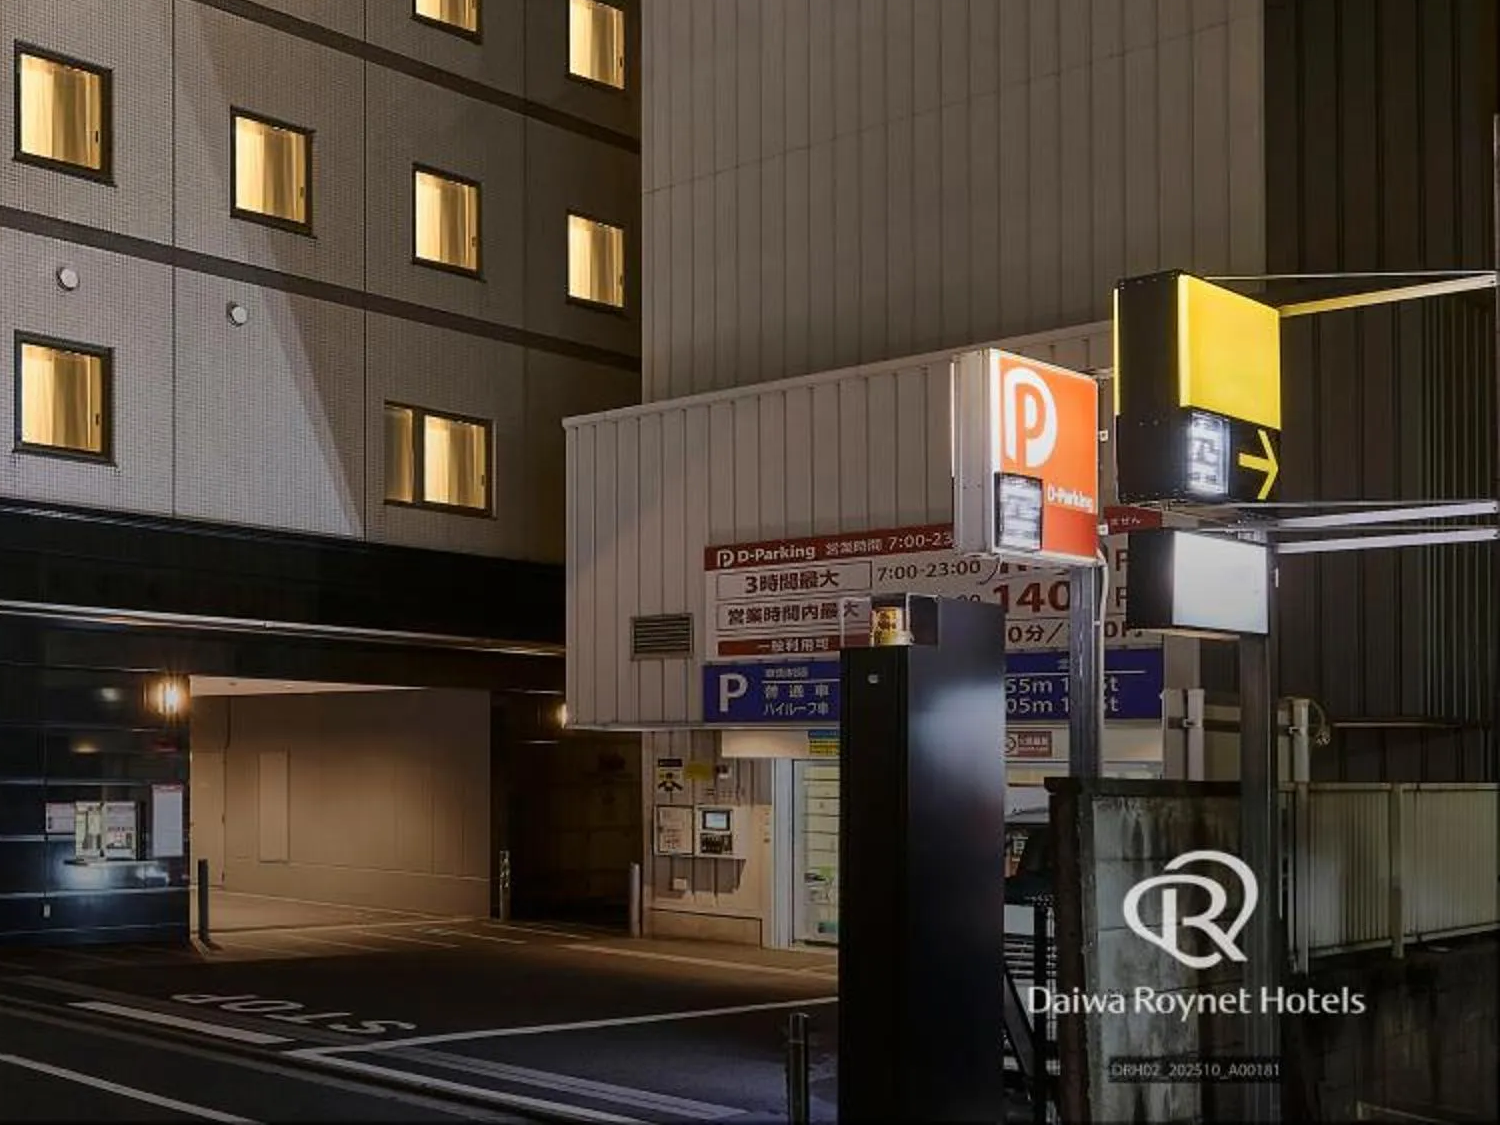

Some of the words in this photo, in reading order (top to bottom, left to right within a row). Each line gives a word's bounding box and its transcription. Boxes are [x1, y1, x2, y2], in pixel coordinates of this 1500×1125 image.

[737, 544, 817, 563] D-Parking
[876, 559, 982, 582] 7:00-23:00
[719, 673, 748, 713] P
[170, 993, 416, 1035] STOP
